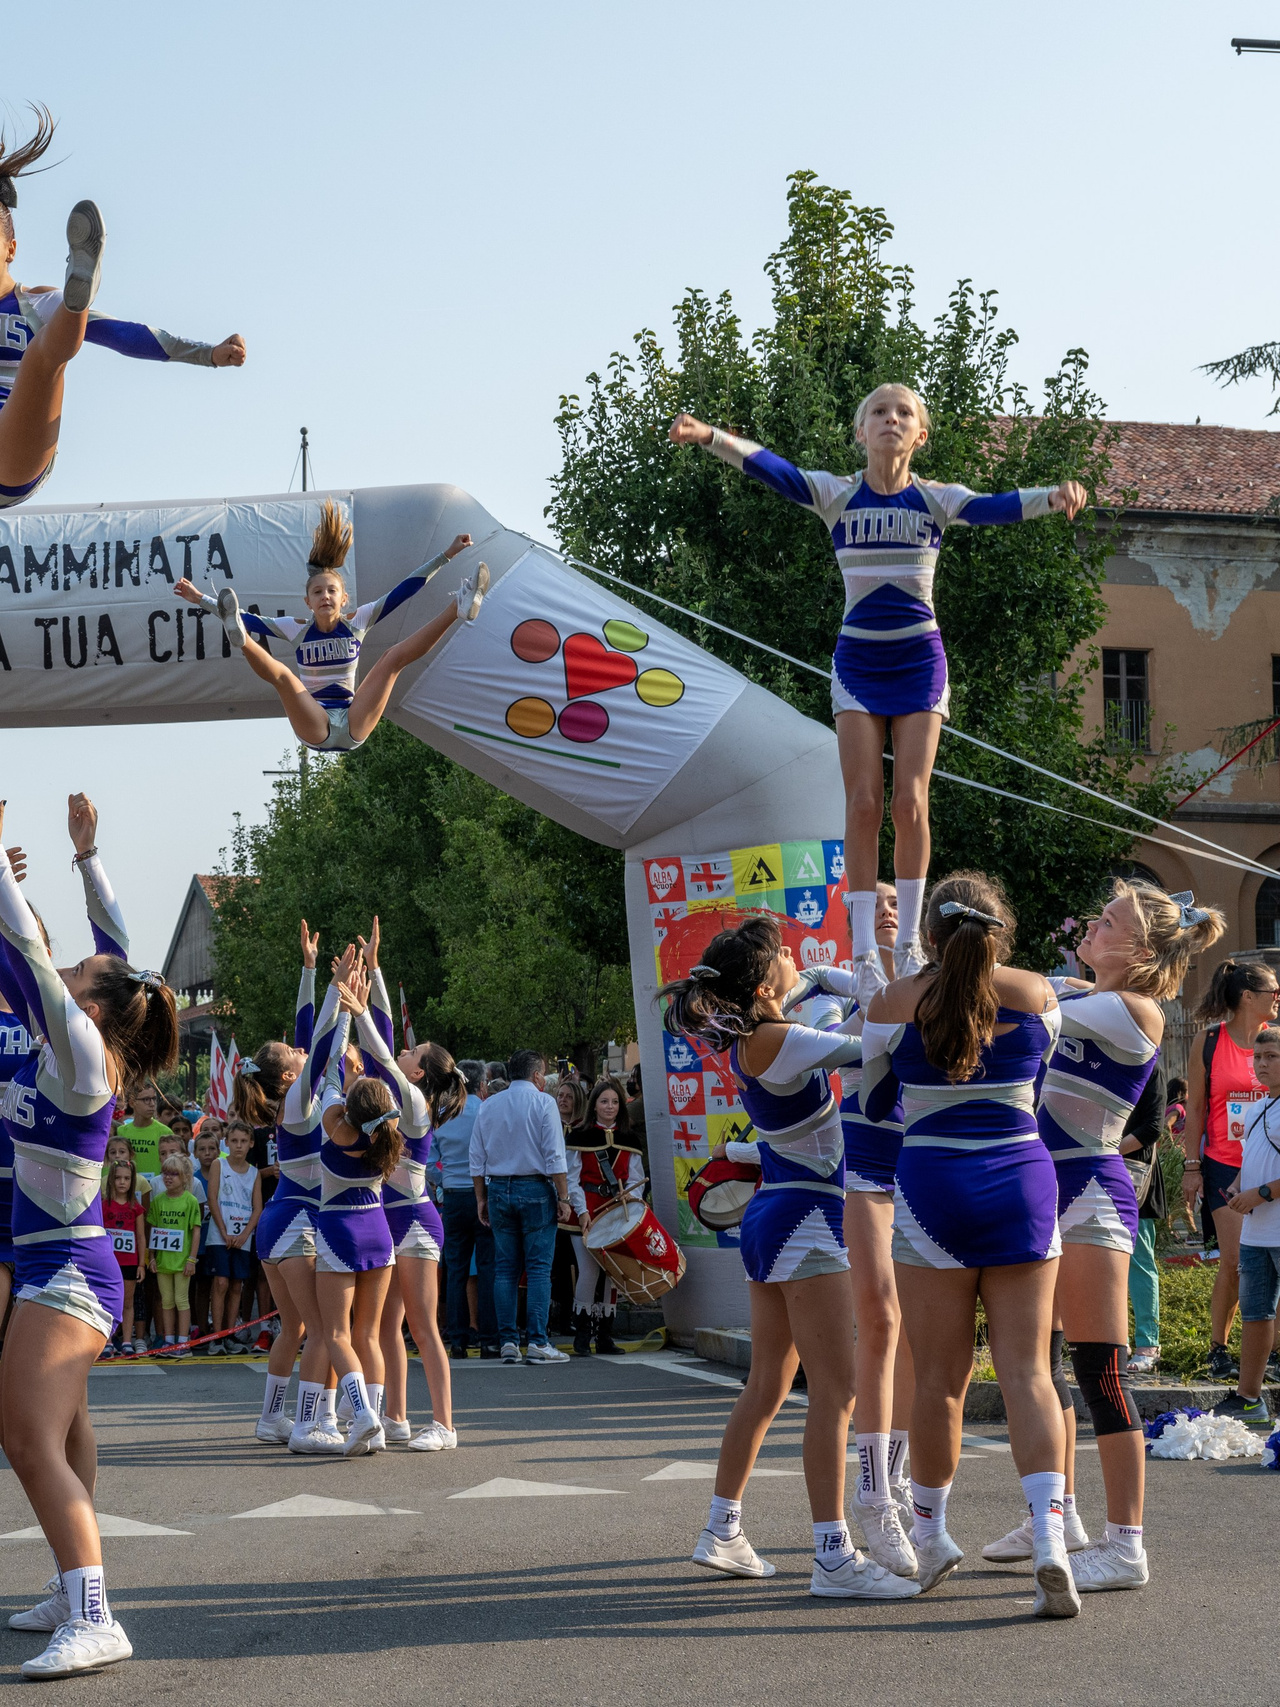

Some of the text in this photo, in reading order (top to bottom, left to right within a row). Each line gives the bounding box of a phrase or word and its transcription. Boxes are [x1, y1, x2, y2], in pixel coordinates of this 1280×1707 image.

[840, 507, 934, 547] TITANS
[34, 613, 124, 670] TUA
[300, 637, 357, 665] TITANS
[653, 871, 673, 883] ALBA
[807, 946, 832, 963] ALBA
[670, 1084, 691, 1096] ALBA
[1230, 1103, 1242, 1115] 13
[152, 1235, 181, 1250] 114
[272, 1385, 286, 1414] TITANS
[303, 1391, 316, 1422] TITANS
[347, 1379, 362, 1412] TITANS
[858, 1446, 871, 1492] TITANS
[88, 1575, 105, 1623] TITANS
